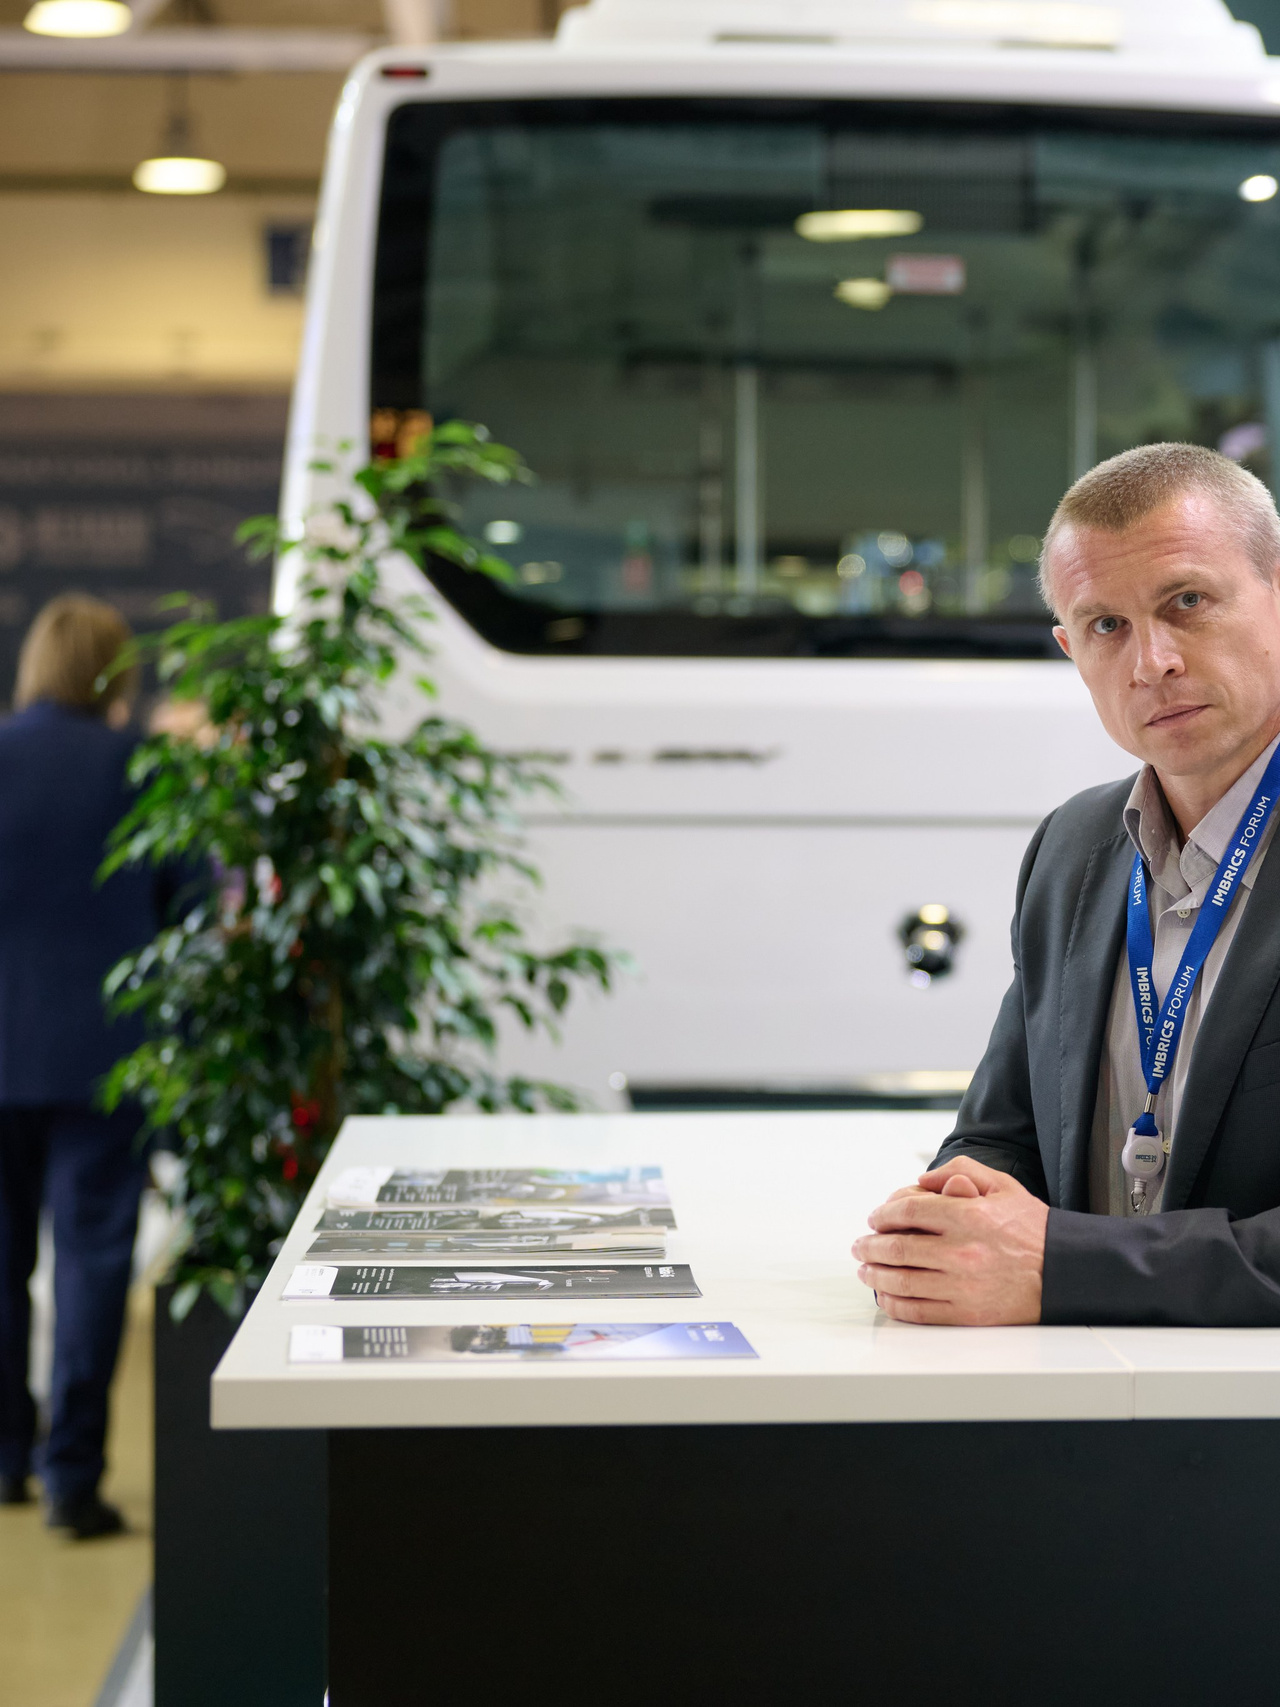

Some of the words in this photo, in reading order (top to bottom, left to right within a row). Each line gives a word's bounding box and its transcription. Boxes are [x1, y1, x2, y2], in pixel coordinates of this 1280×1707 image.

[1133, 858, 1143, 906] ORUM
[1212, 848, 1246, 907] IMBRICS
[1240, 796, 1271, 847] FORUM
[1136, 966, 1154, 1024] IMBRICS
[1152, 1020, 1175, 1078] IMBRICS
[1167, 965, 1195, 1019] FORUM
